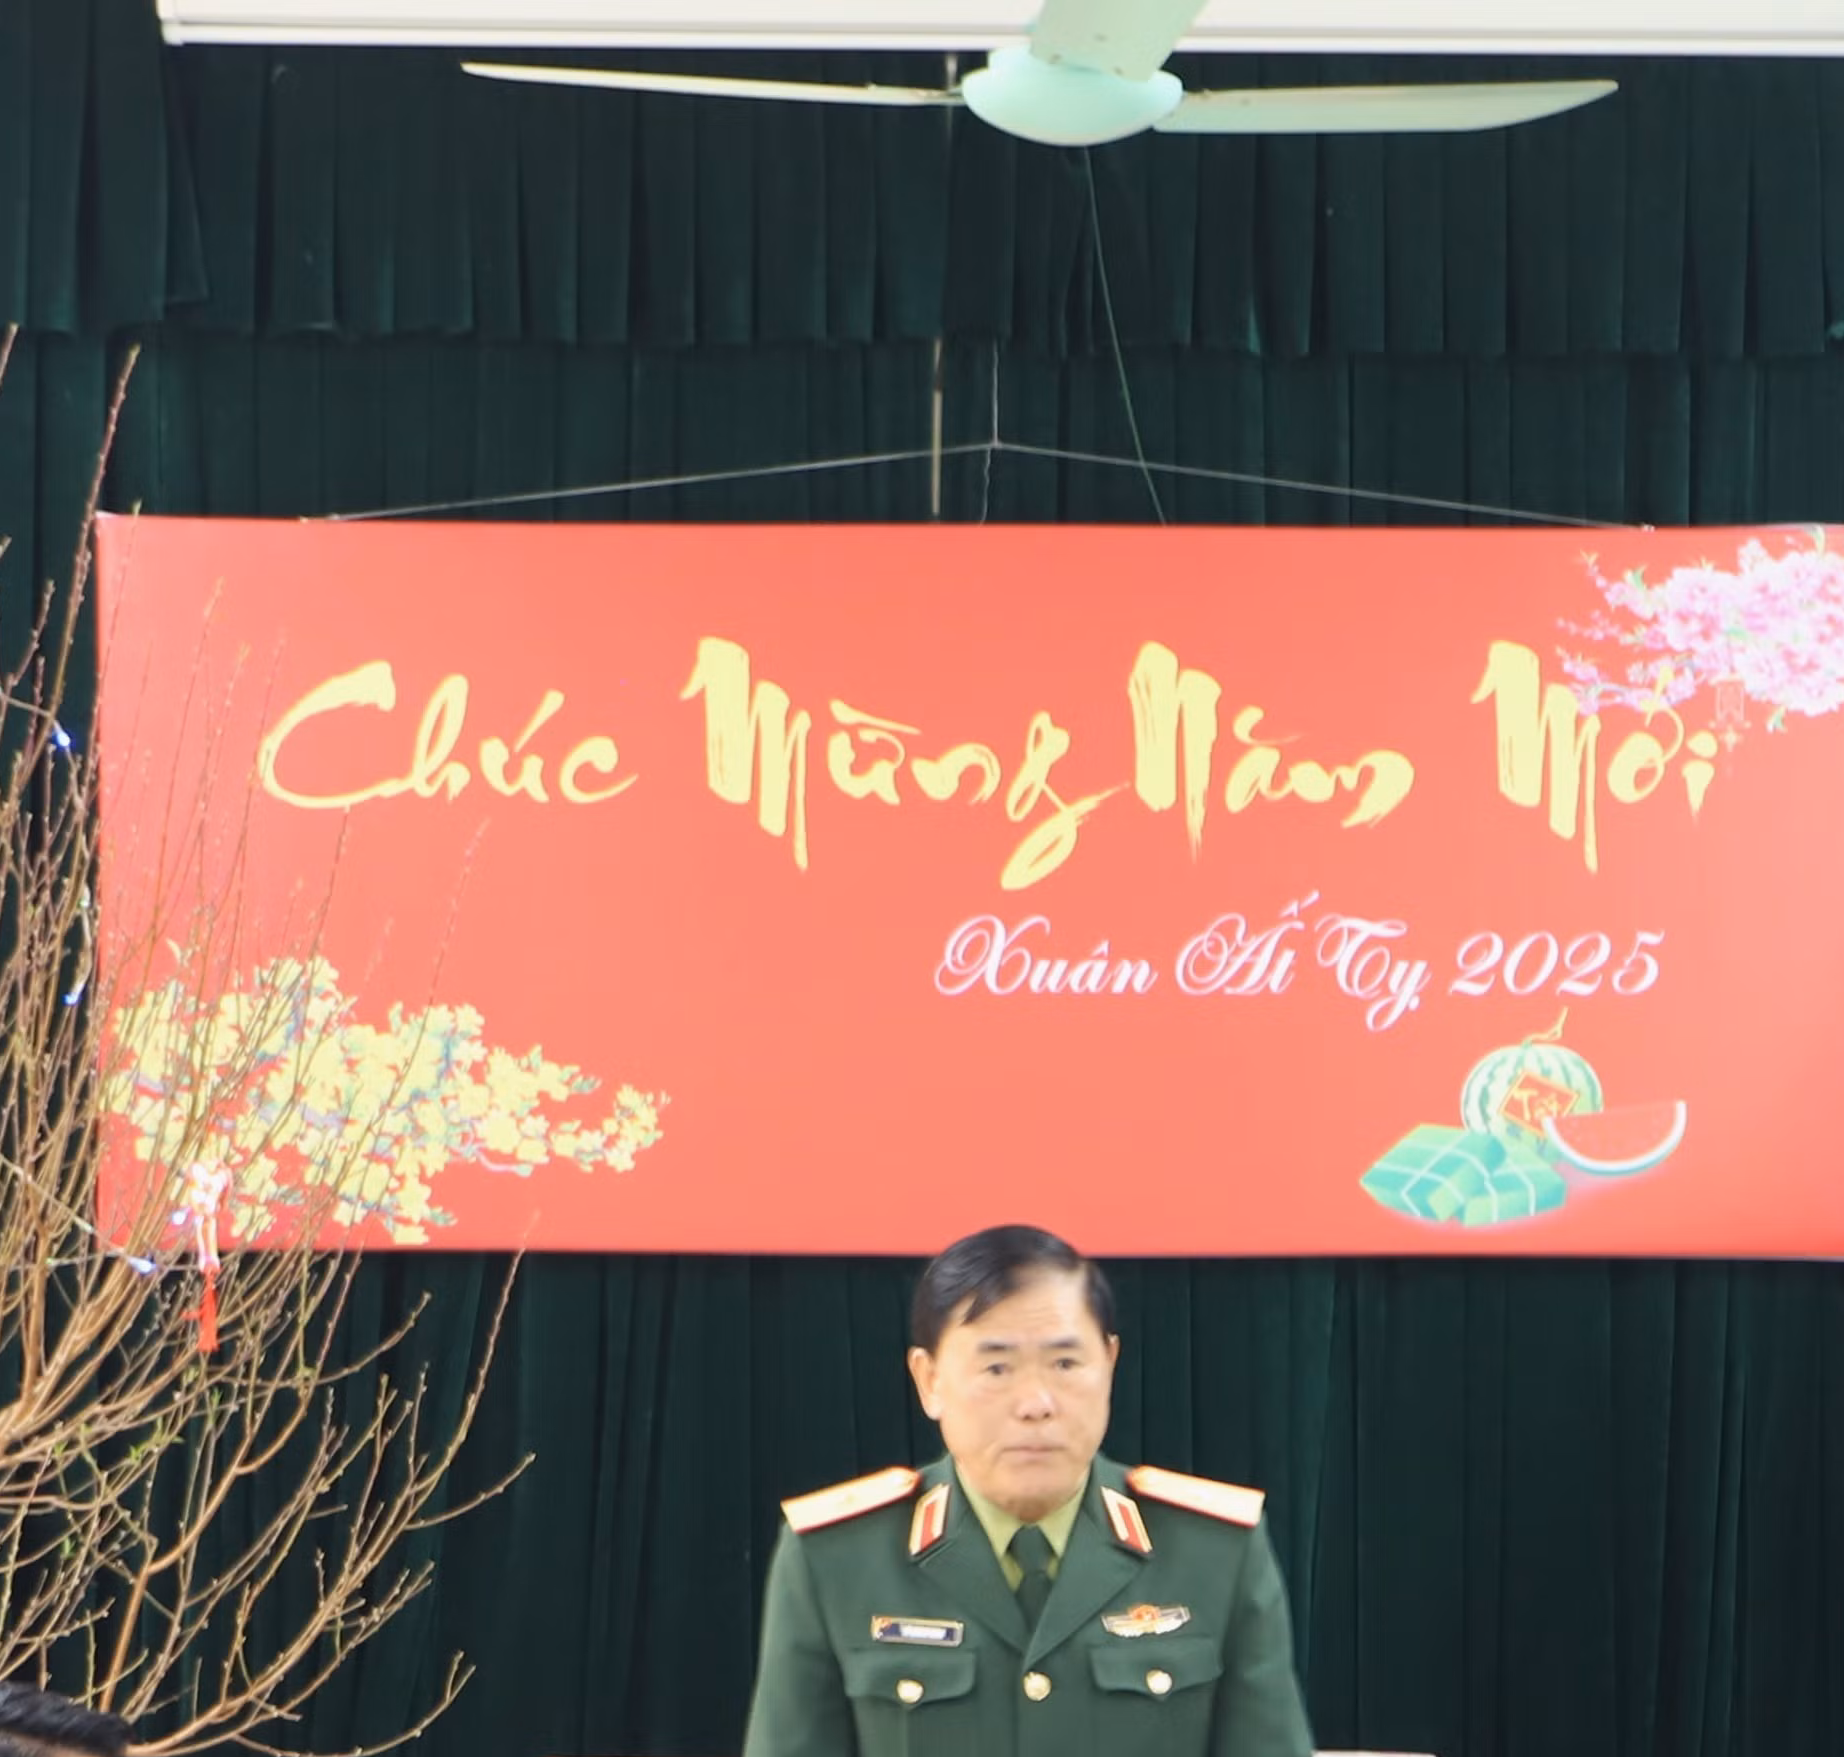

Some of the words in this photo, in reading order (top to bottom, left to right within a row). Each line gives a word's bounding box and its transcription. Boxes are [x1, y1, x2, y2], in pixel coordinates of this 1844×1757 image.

[257, 659, 638, 809] Chúc
[680, 637, 1131, 890] Mừng
[1128, 640, 1415, 864] Năm
[1471, 640, 1719, 873] Mới
[934, 914, 1157, 996] Xuân
[1314, 912, 1431, 1032] Tỵ
[1449, 929, 1665, 996] 2025
